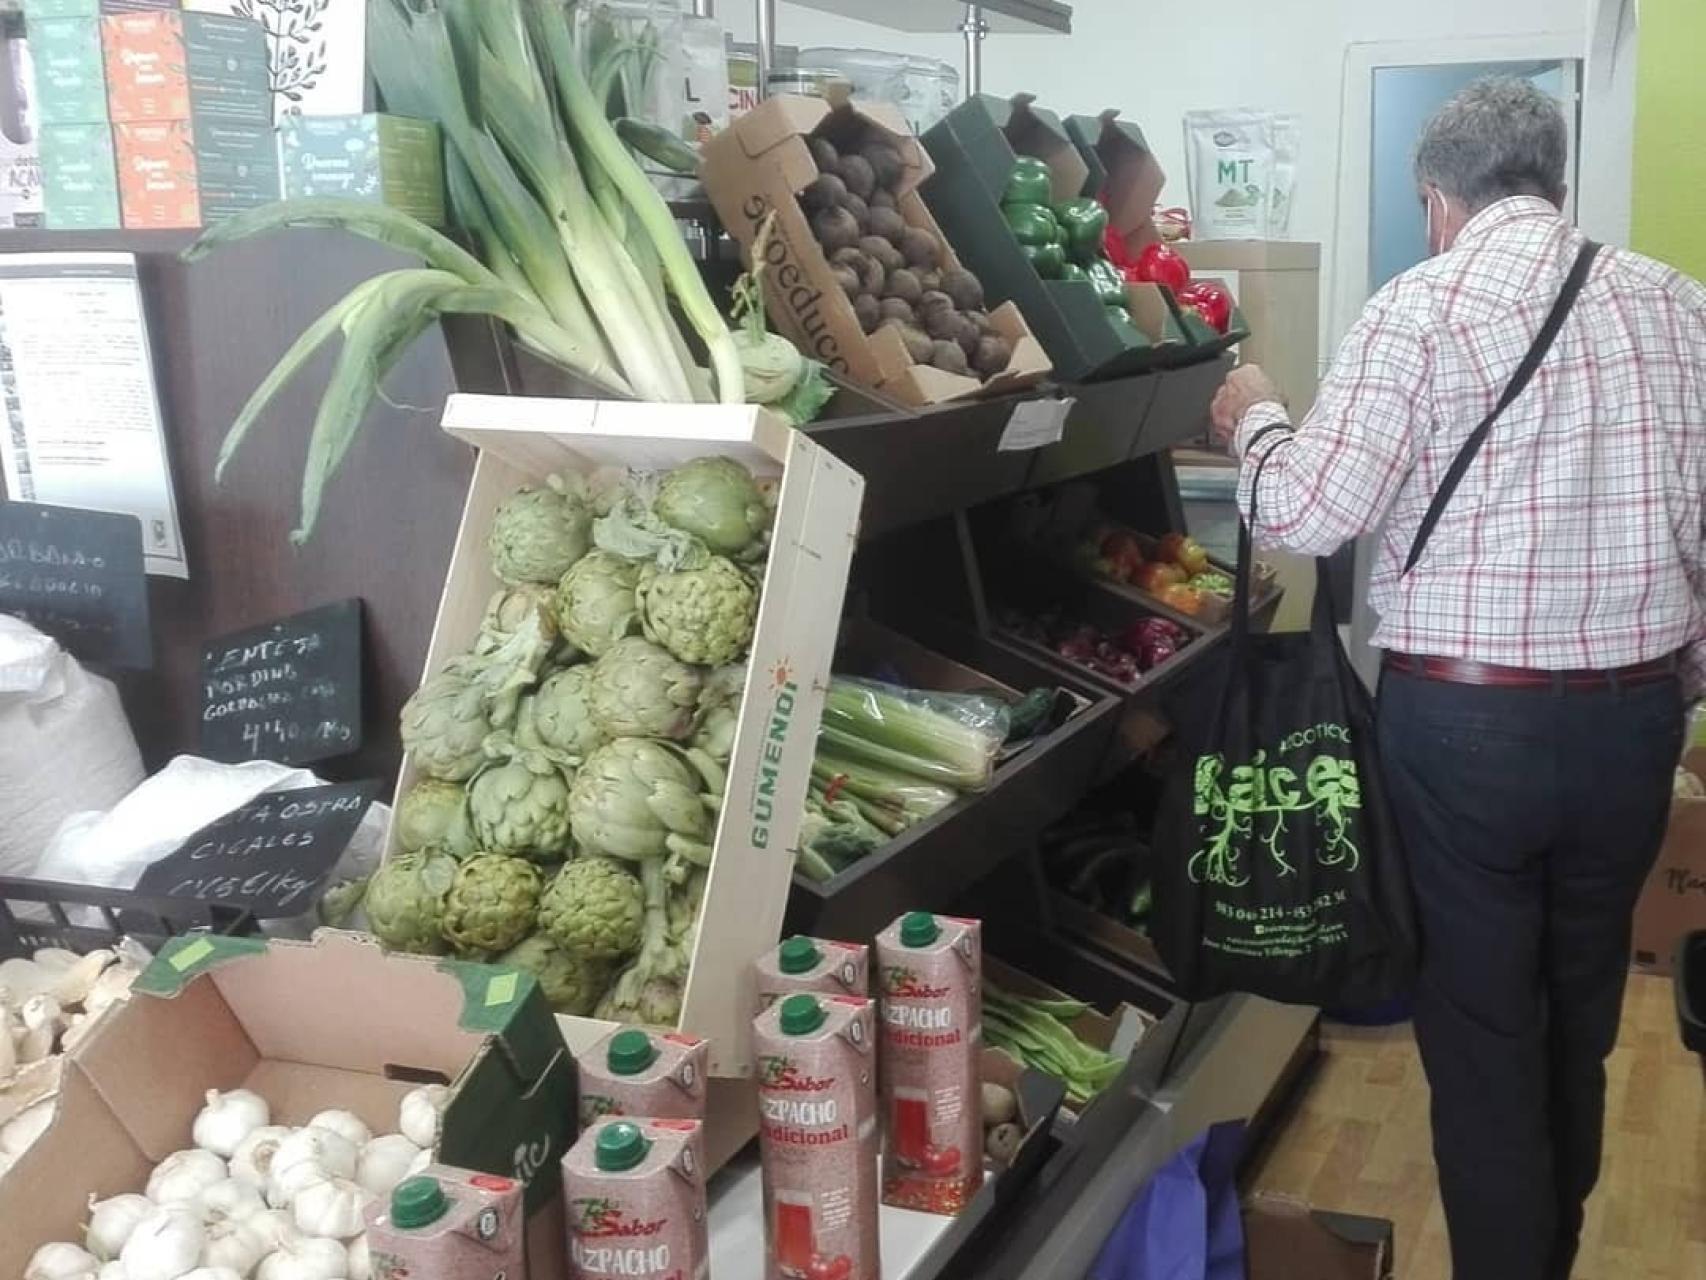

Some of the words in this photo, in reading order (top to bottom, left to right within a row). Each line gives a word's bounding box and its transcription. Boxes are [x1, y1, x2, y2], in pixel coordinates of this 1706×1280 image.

[1218, 159, 1254, 183] MT
[752, 681, 798, 850] GUMENDI
[882, 1000, 951, 1029] ZPACHO
[760, 1068, 835, 1092] Sabor
[762, 1098, 837, 1127] ZPACHO
[579, 1210, 667, 1238] Sabor
